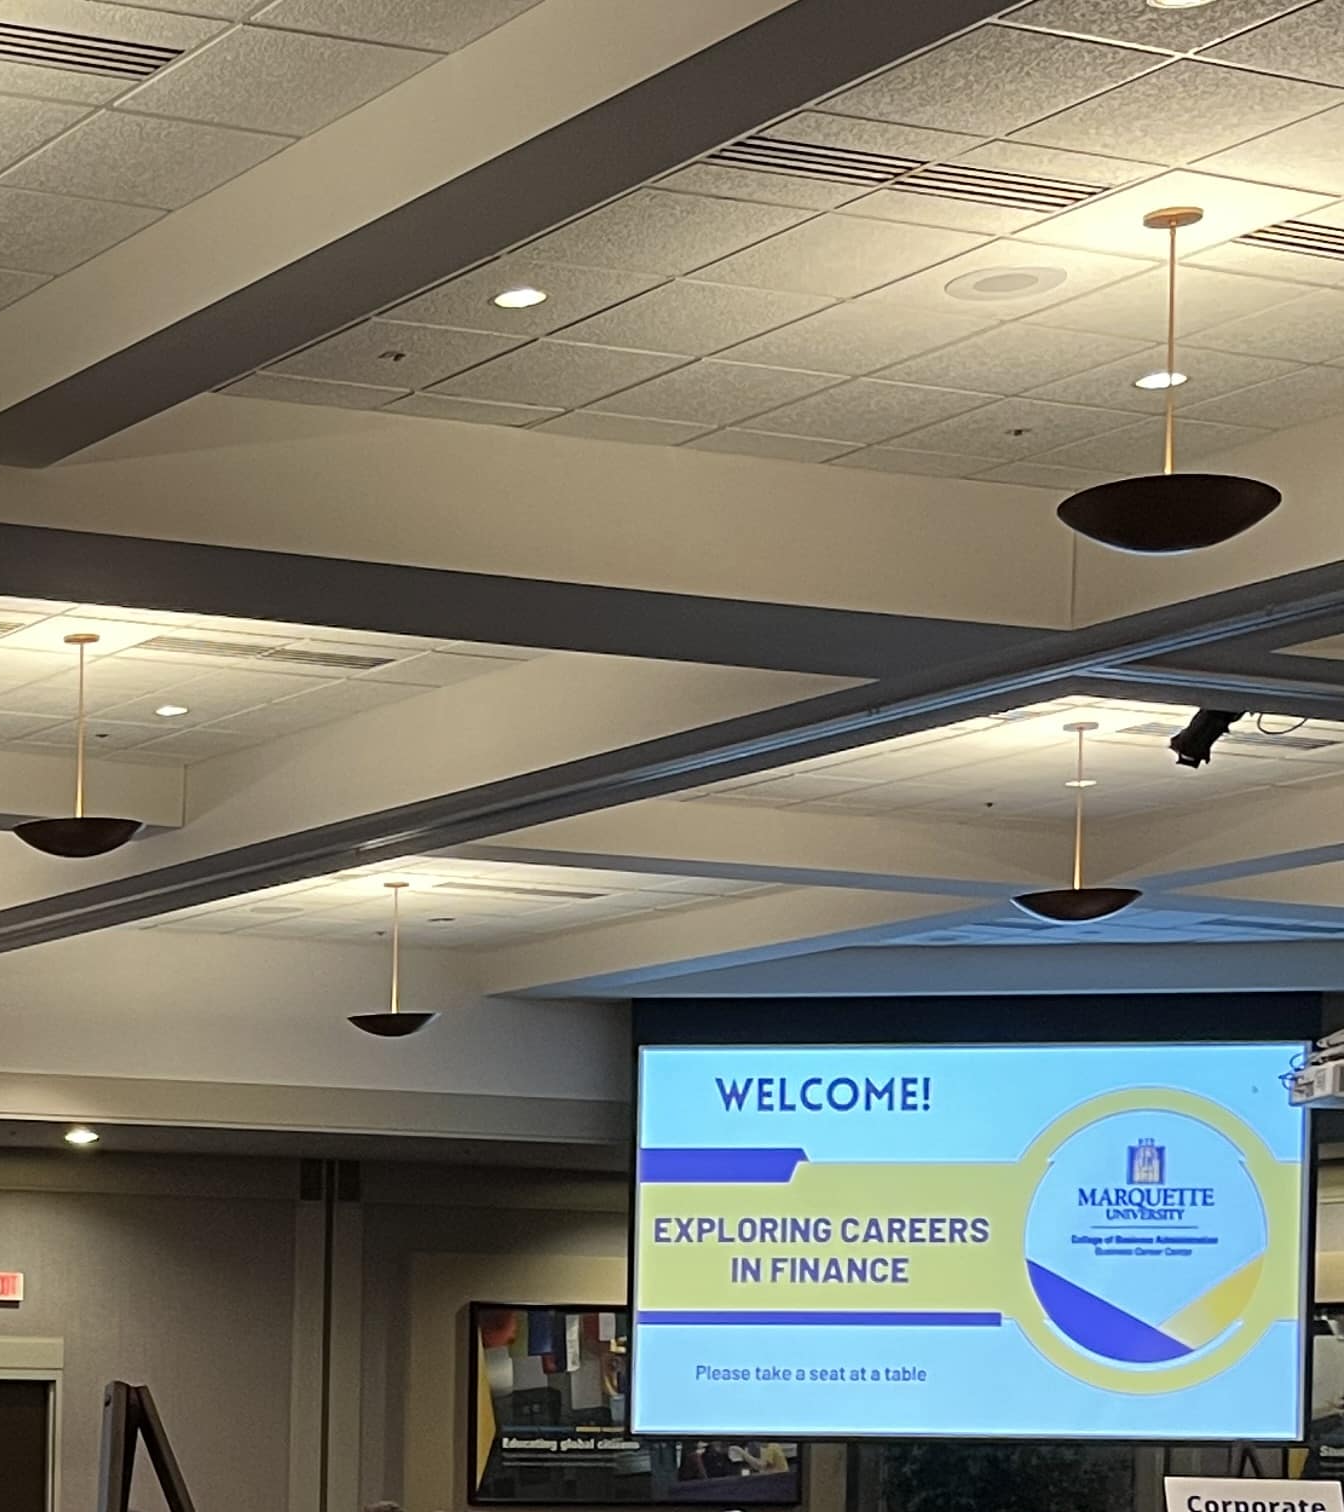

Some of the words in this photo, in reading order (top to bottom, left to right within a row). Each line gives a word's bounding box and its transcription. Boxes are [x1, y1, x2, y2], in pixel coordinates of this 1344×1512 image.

[715, 1077, 930, 1111] WELCOME!
[1078, 1188, 1216, 1208] MARQUETTE
[1106, 1208, 1184, 1221] UNIVERSITY
[654, 1218, 832, 1243] EXPLORING
[841, 1218, 990, 1243] CAREERS
[731, 1257, 761, 1283] IN
[770, 1257, 909, 1283] FINANCE
[695, 1365, 750, 1381] Please
[755, 1366, 792, 1381] take
[796, 1368, 805, 1381] a
[809, 1367, 846, 1382] seat
[850, 1367, 866, 1382] at
[870, 1369, 880, 1382] a
[885, 1366, 928, 1382] table
